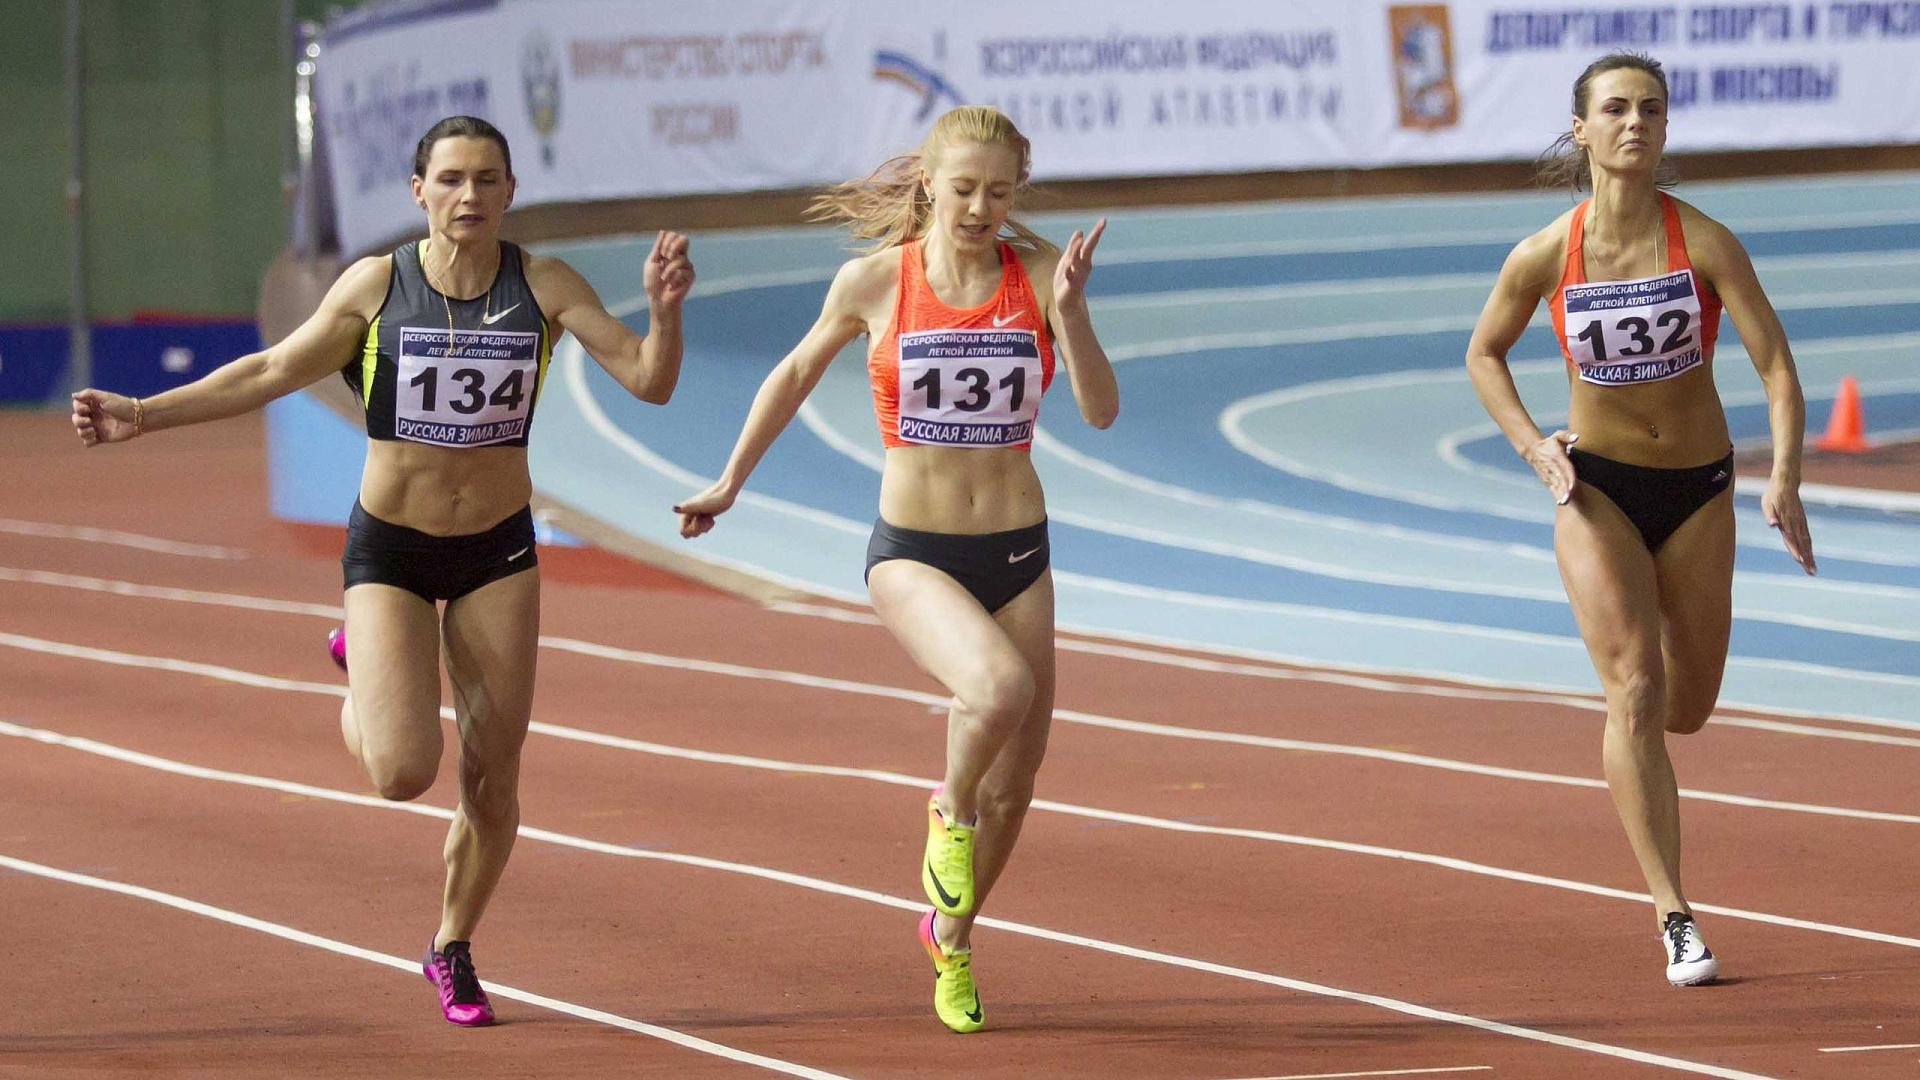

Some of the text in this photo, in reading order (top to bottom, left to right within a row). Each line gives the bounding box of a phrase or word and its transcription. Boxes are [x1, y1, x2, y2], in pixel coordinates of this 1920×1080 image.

[1639, 274, 1688, 292] ФЕДЕРАЦИЯ
[1589, 292, 1669, 309] ЛЕГКОЙ АТЛЕТИКИ
[481, 335, 534, 347] ФЕДЕРАЦИЯ
[902, 333, 979, 347] ВСЕРОССИЙСКАЯ
[1578, 309, 1693, 361] 132
[464, 348, 512, 359] АТЛЕТИКИ
[927, 345, 1013, 357] ЛЕГКОЙ АТЛЕТИКИ
[1582, 350, 1699, 381] РУССКАЯ ЗИМА 2017
[410, 366, 525, 415] 134
[912, 366, 1026, 413] 131
[400, 420, 523, 443] РУССКАЯ ЗИМА 2017
[901, 420, 1030, 442] РУССКАЯ ЗИМА 2017
